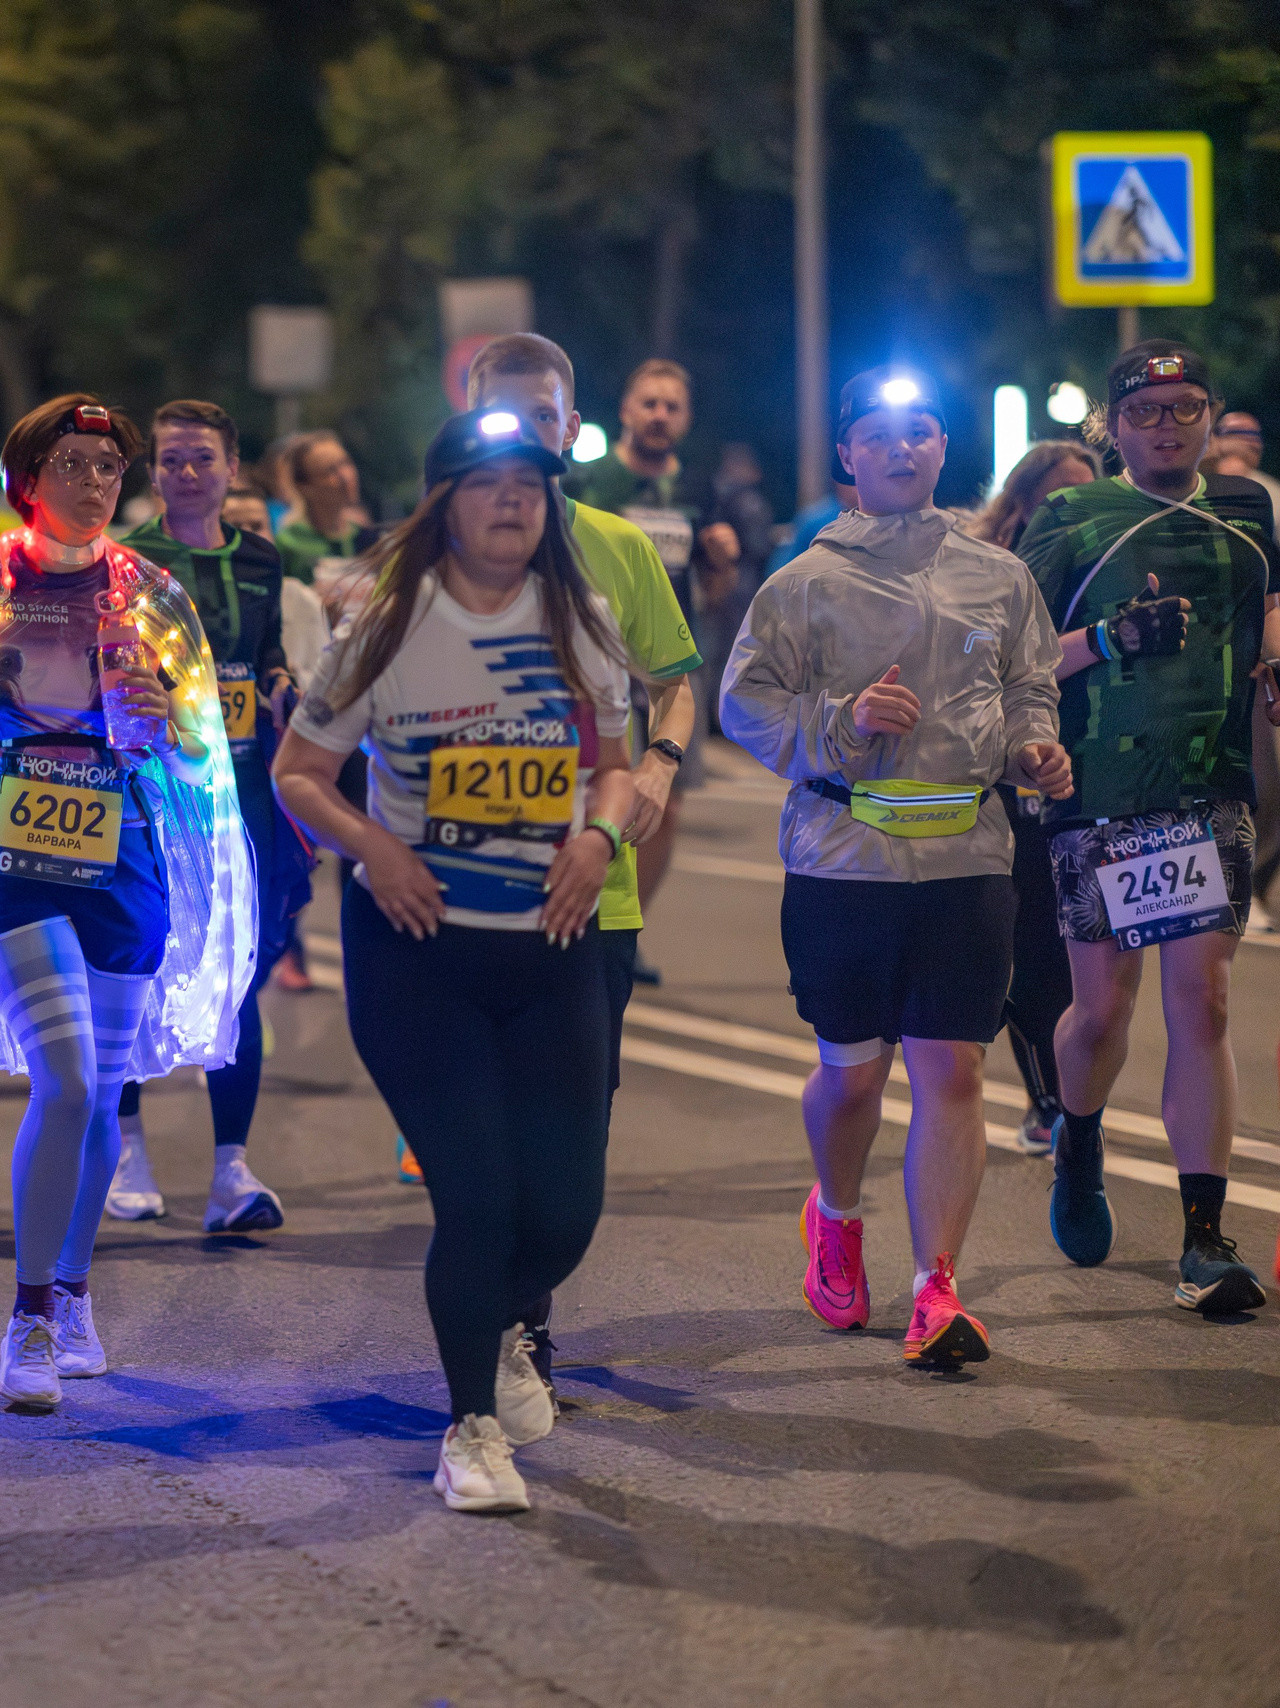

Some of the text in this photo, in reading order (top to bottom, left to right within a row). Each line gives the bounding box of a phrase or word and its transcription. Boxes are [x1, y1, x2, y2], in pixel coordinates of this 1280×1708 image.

[5, 612, 69, 624] MARATHON
[28, 604, 68, 613] SPACE
[441, 758, 569, 799] 12106
[10, 791, 106, 838] 6202
[900, 811, 960, 823] DEMIX
[27, 832, 82, 850] ВАРВАРА
[439, 822, 459, 845] G
[1117, 854, 1208, 905] 2494
[1135, 892, 1199, 917] АЛЕКСАНДР
[1127, 928, 1142, 947] G
